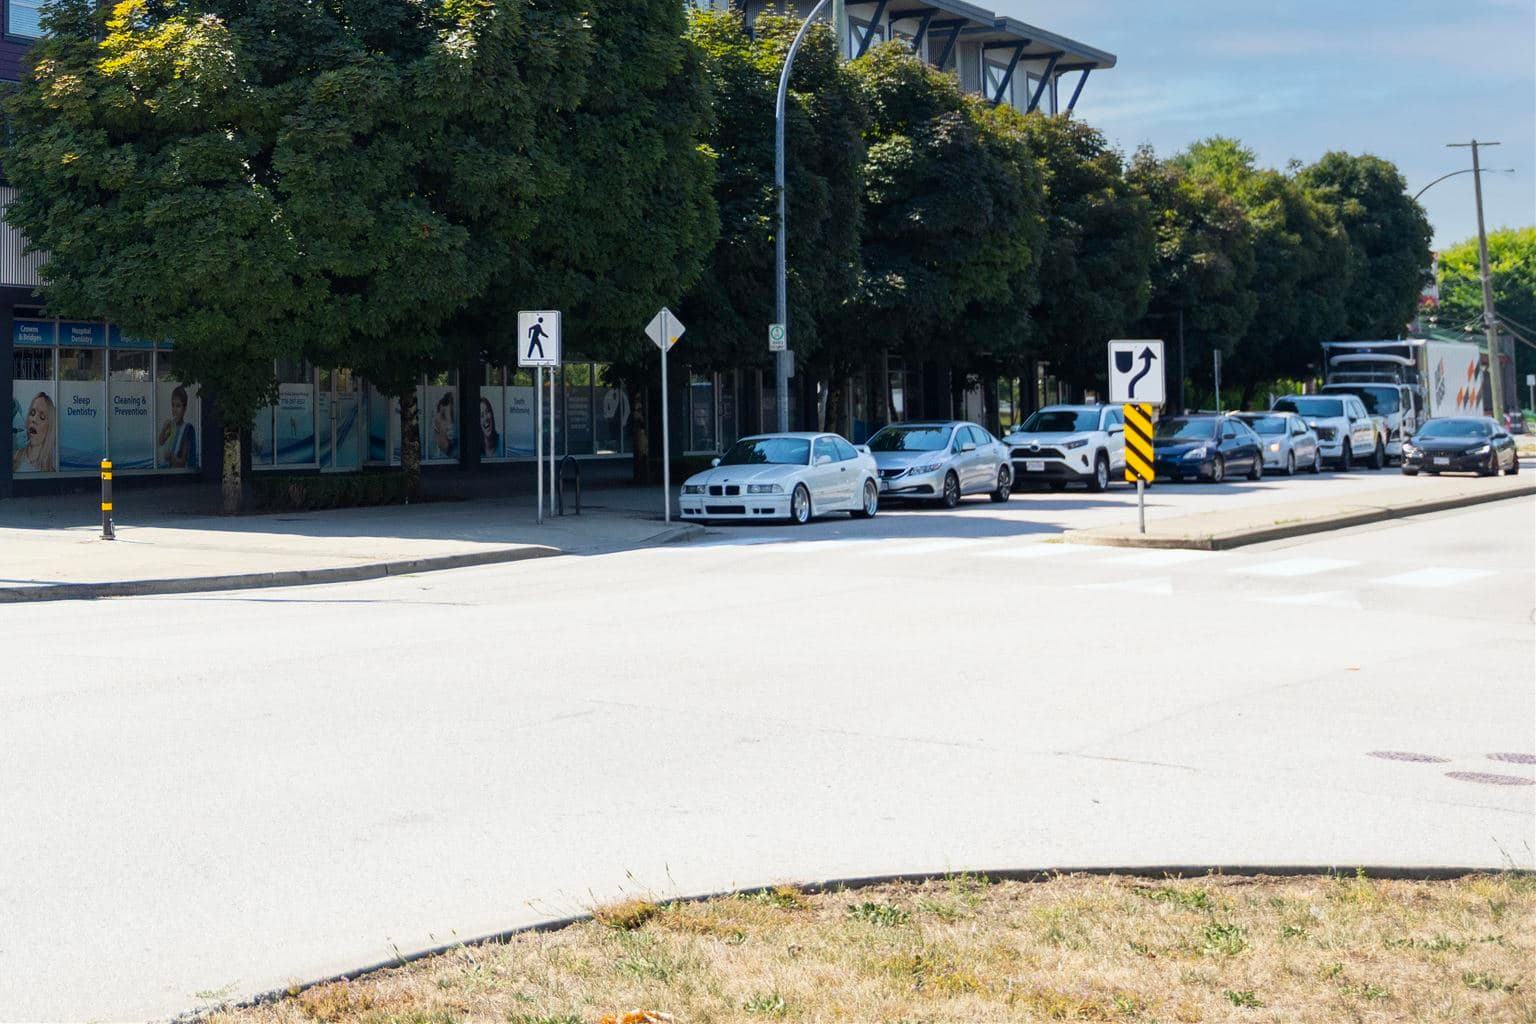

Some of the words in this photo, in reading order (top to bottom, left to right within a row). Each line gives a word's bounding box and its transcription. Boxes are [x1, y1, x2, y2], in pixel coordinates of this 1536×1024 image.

[71, 327, 92, 336] Hospital
[71, 336, 93, 344] Dentistry
[72, 395, 91, 406] Sleep
[113, 395, 141, 406] Cleaning
[141, 396, 147, 405] &
[67, 407, 97, 417] Dentistry
[114, 407, 148, 417] Prevention
